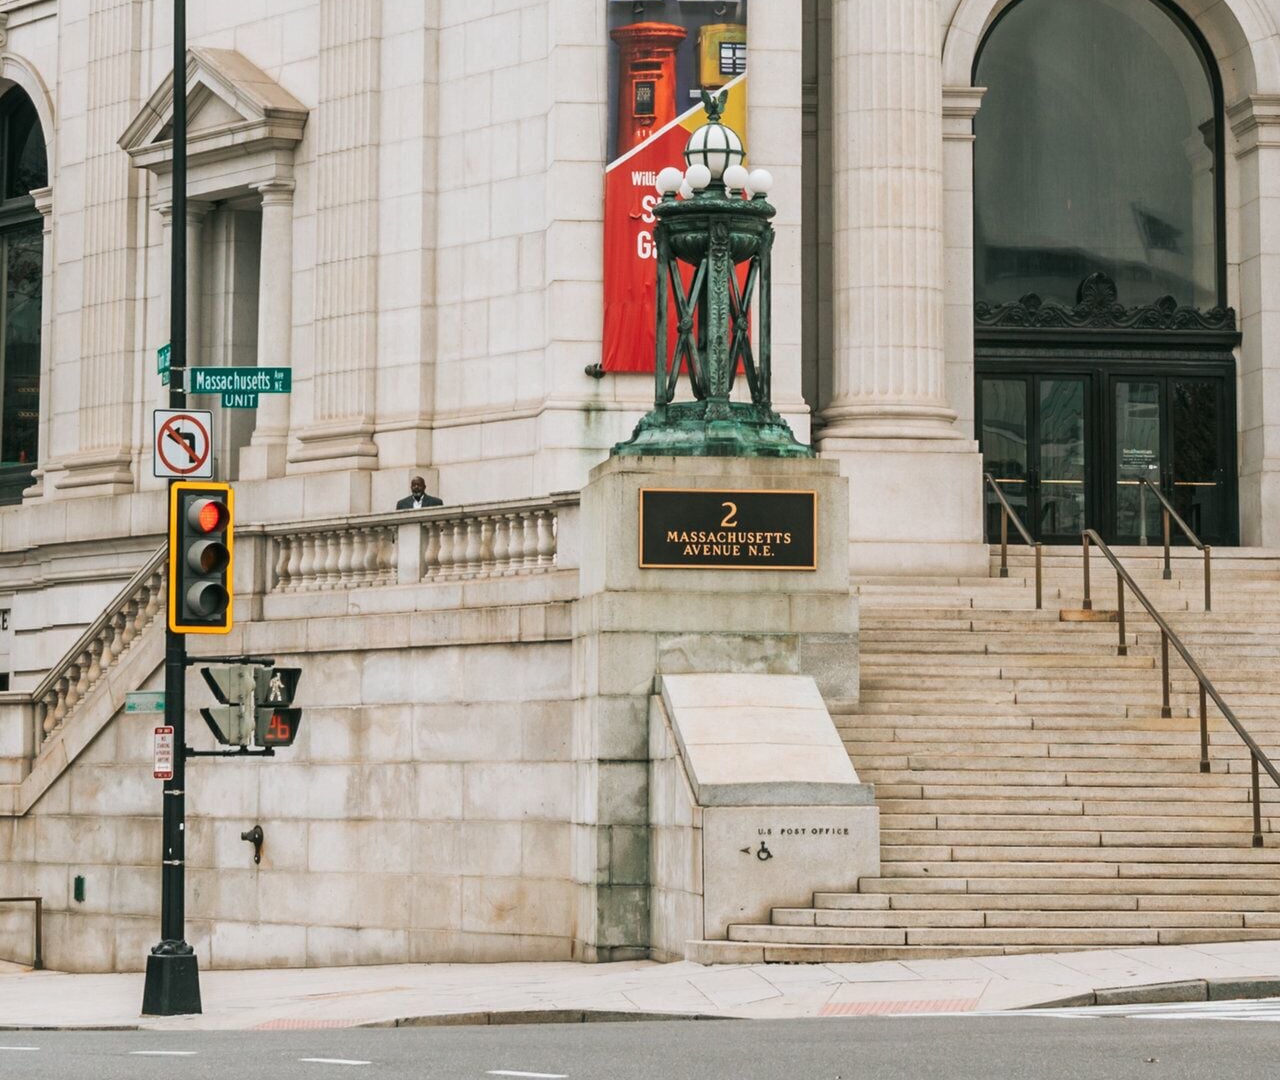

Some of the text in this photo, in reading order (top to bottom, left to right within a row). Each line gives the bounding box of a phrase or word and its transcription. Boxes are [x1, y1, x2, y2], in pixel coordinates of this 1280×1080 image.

[196, 370, 284, 391] Massachusetts Ave NE
[225, 394, 255, 407] UNIT
[720, 501, 738, 528] 2
[666, 531, 792, 545] MASSACHUSETTS
[683, 544, 775, 557] AVENUE N.E.
[780, 828, 806, 836] POST
[811, 828, 850, 836] OFFICE
